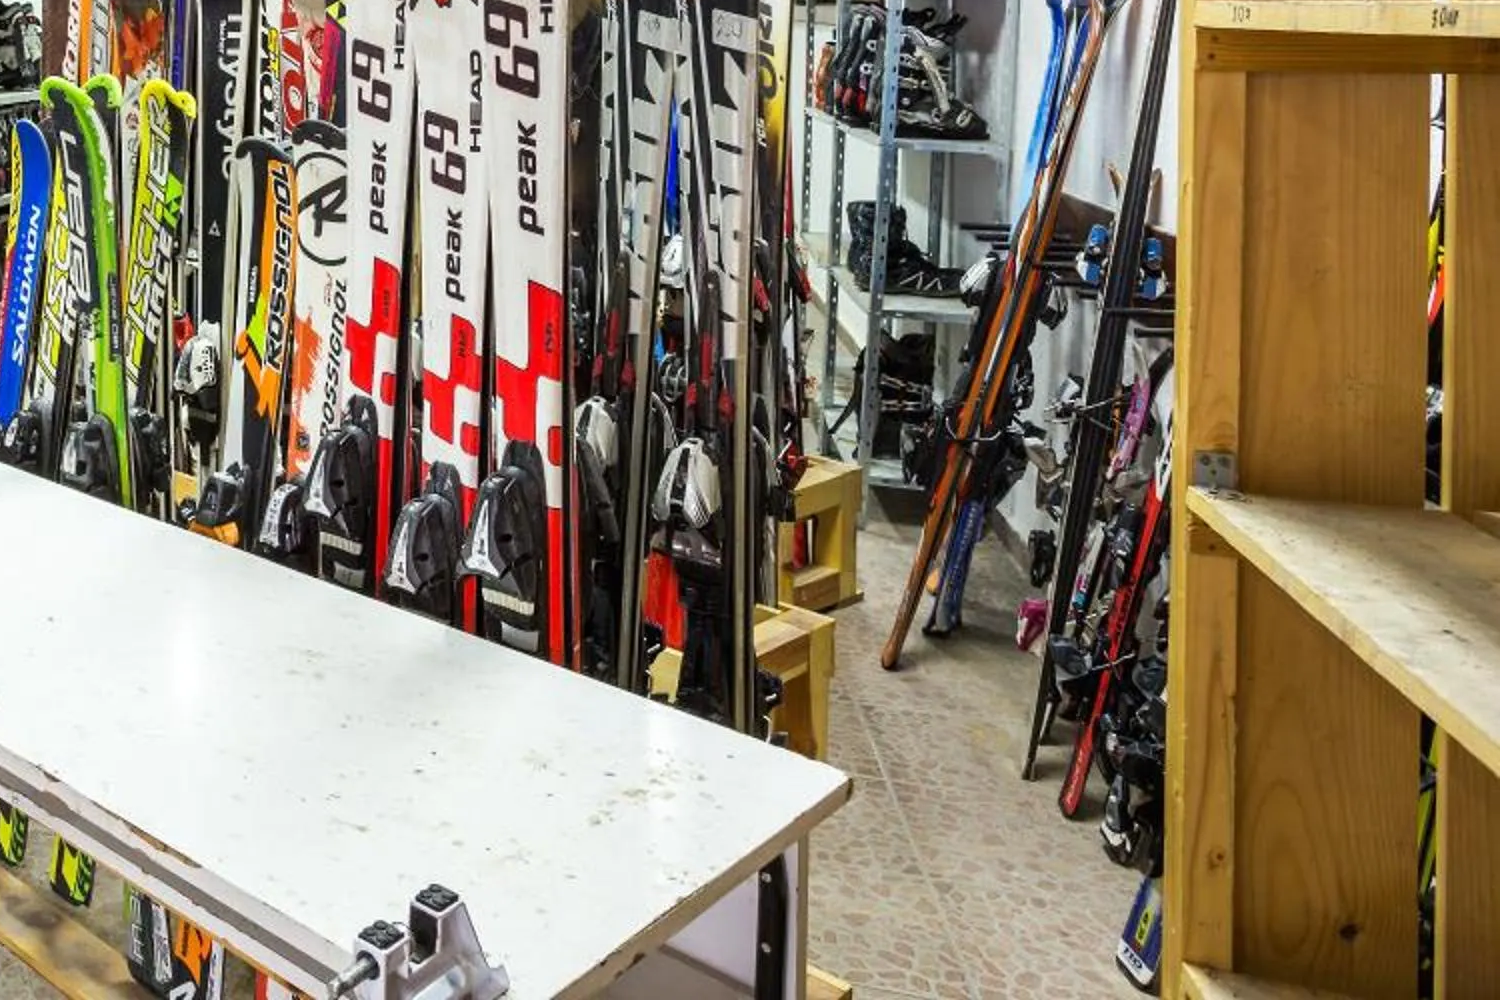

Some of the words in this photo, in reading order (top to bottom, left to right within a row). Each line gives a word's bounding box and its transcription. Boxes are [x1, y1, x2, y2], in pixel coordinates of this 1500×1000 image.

[351, 38, 392, 123] 69
[469, 49, 483, 153] HEAD
[370, 140, 389, 235] peak
[423, 109, 466, 195] 69
[517, 119, 545, 236] peak
[59, 130, 92, 304] elan
[125, 95, 171, 388] FISCHER
[266, 163, 293, 371] ROSSIGNOL
[445, 207, 466, 302] peak
[12, 204, 41, 368] SALOMON
[145, 227, 174, 345] RACE
